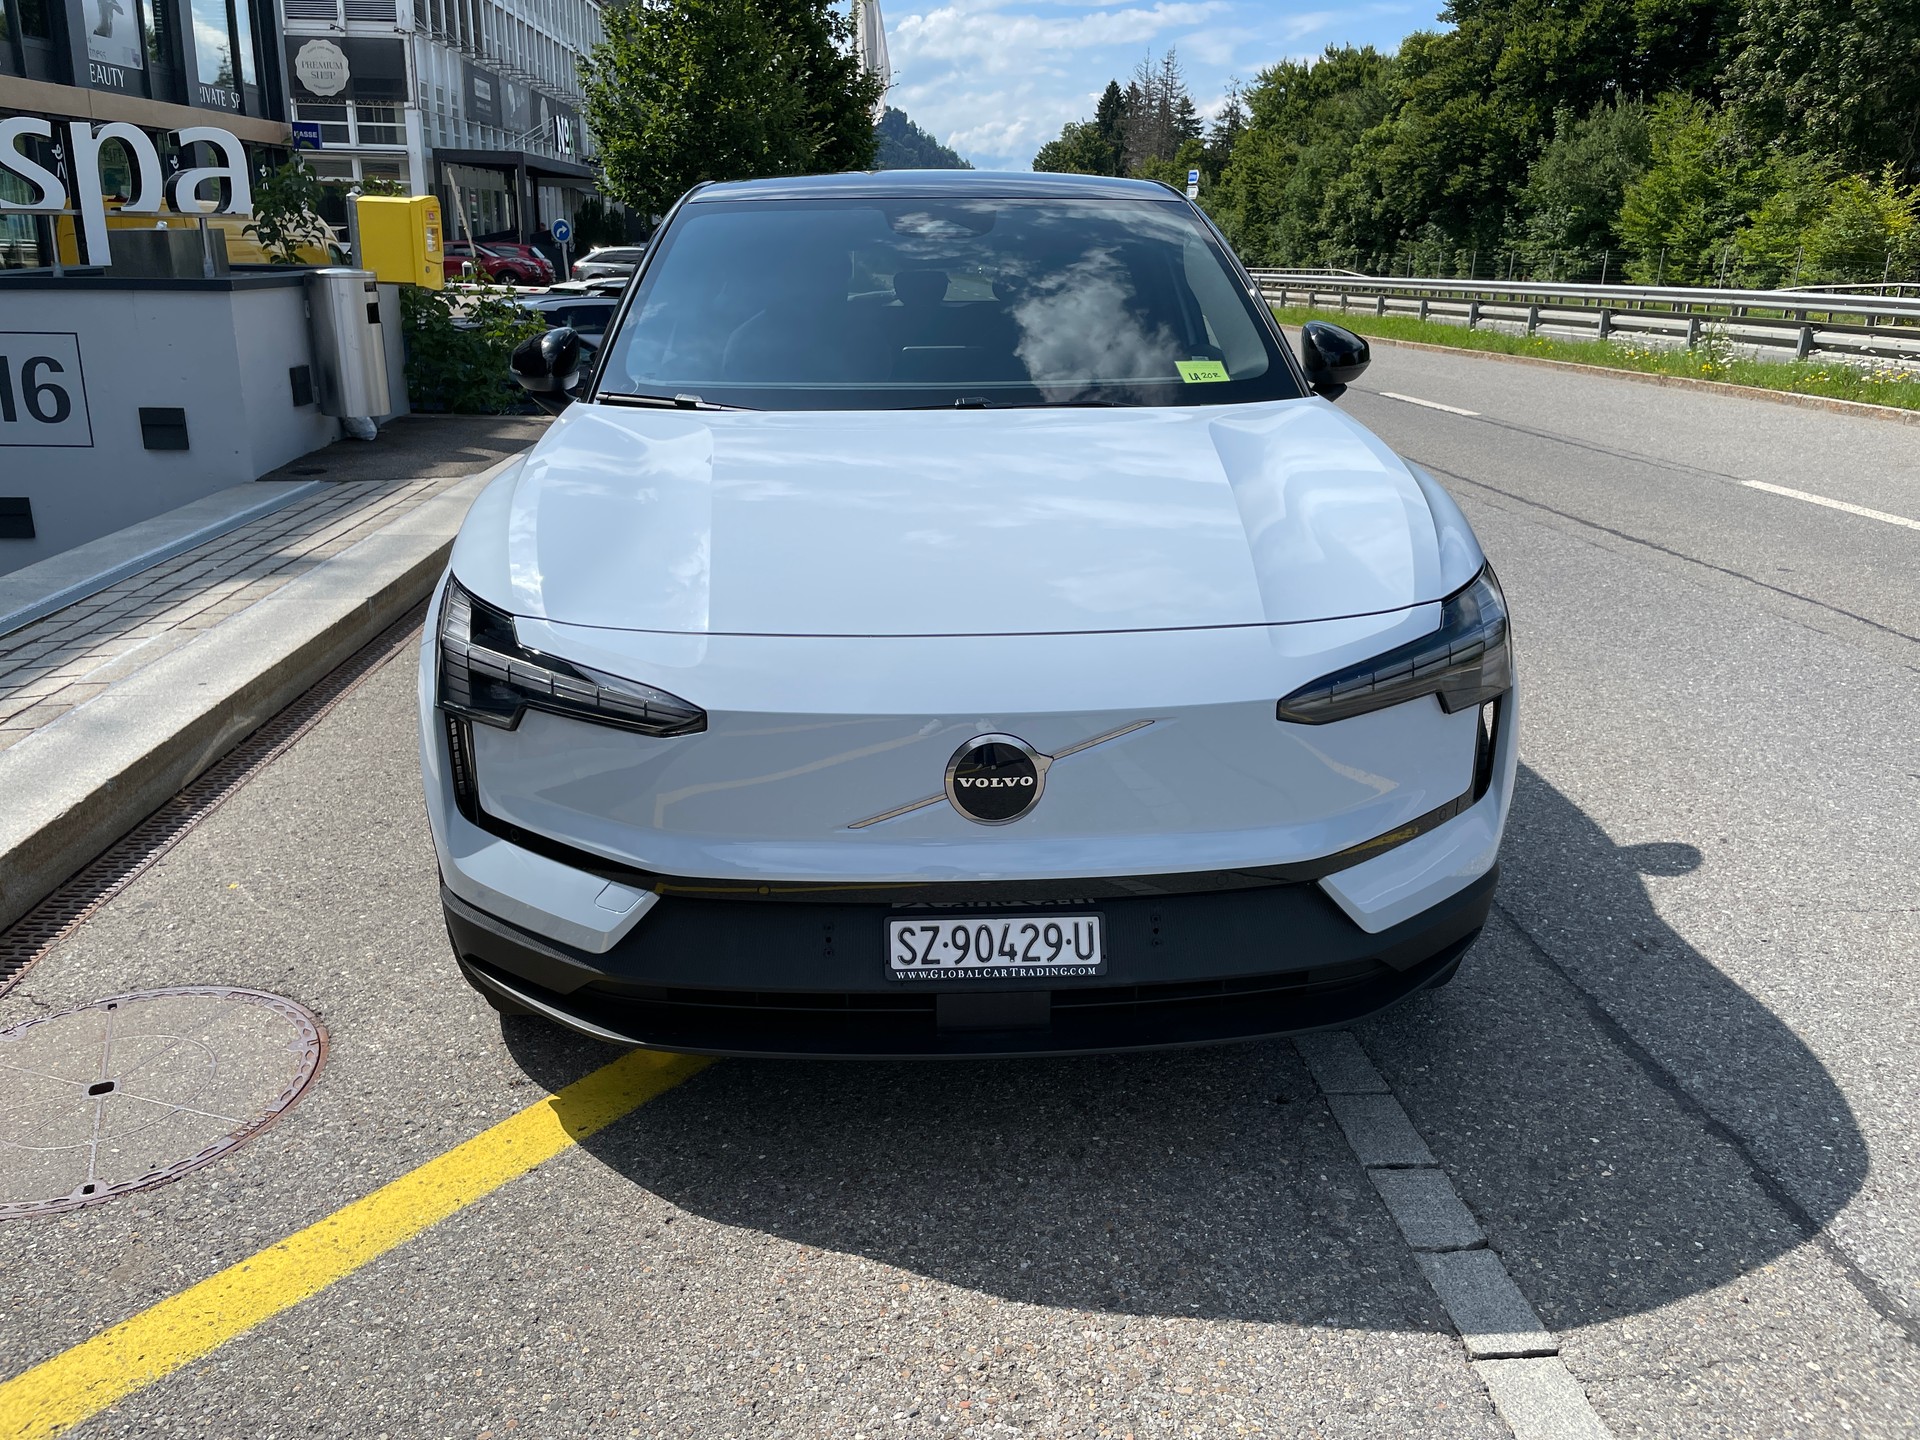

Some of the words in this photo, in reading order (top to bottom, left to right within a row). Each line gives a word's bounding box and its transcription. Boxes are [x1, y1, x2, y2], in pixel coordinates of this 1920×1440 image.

[301, 60, 343, 70] PREMIUM
[293, 130, 318, 138] KASSE
[0, 117, 251, 266] spa
[957, 776, 1034, 788] VOLVO
